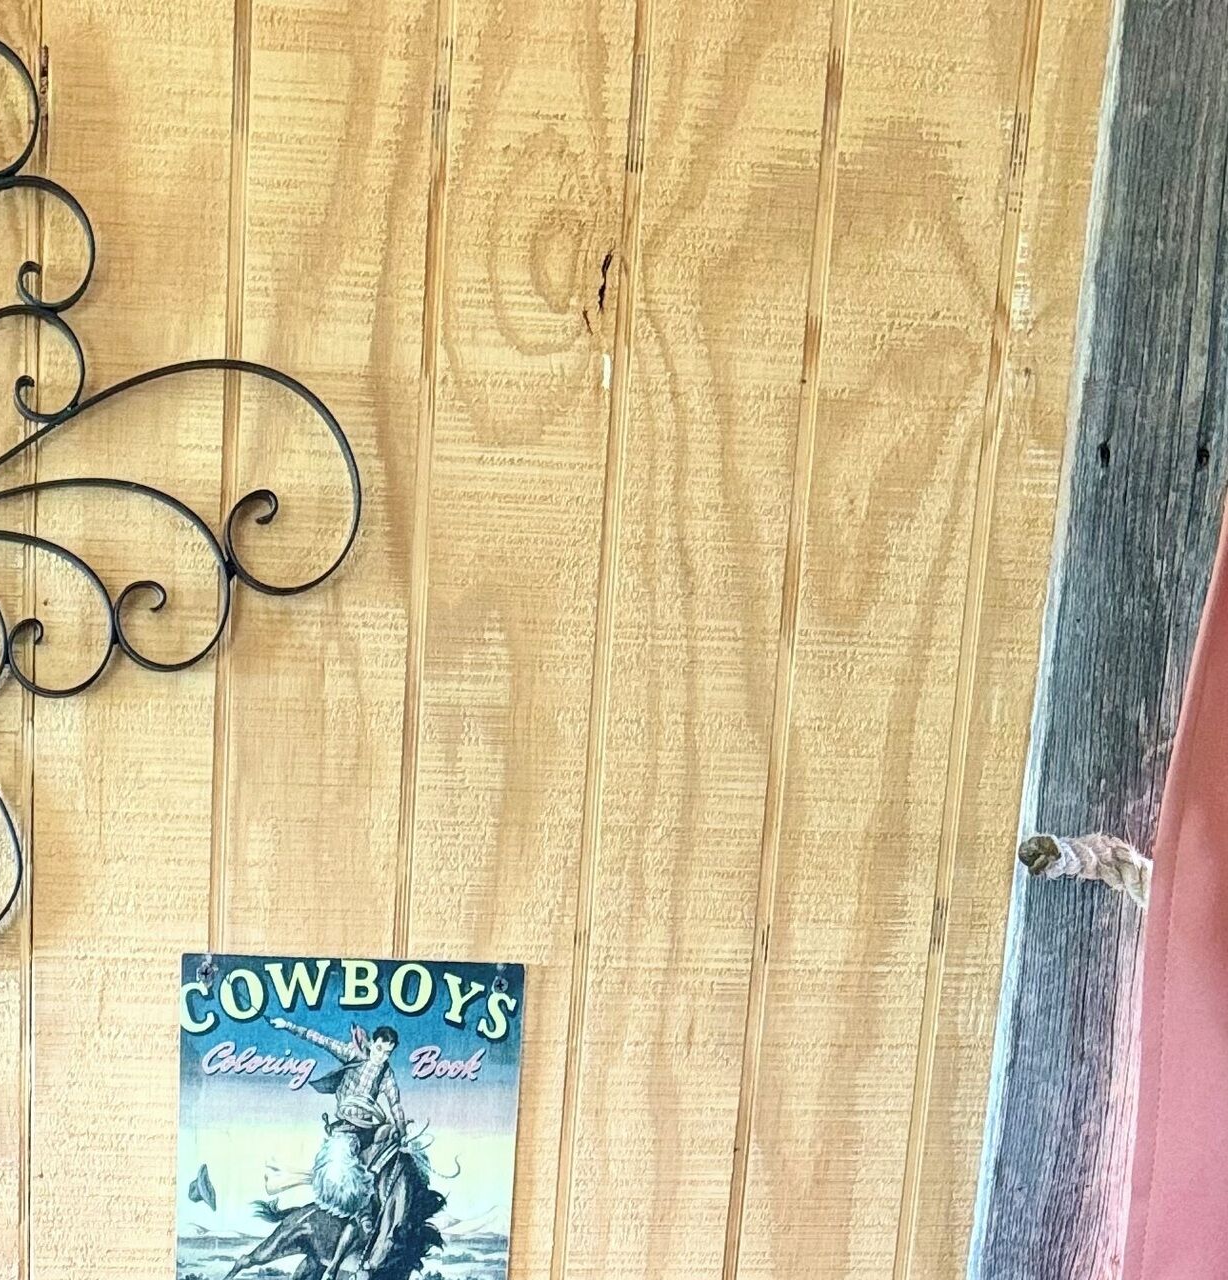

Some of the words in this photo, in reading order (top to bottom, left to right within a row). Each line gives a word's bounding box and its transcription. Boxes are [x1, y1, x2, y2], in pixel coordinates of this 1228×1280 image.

[180, 959, 517, 1039] COWBOYS
[201, 1040, 318, 1090] Coloring
[409, 1045, 486, 1081] Book
